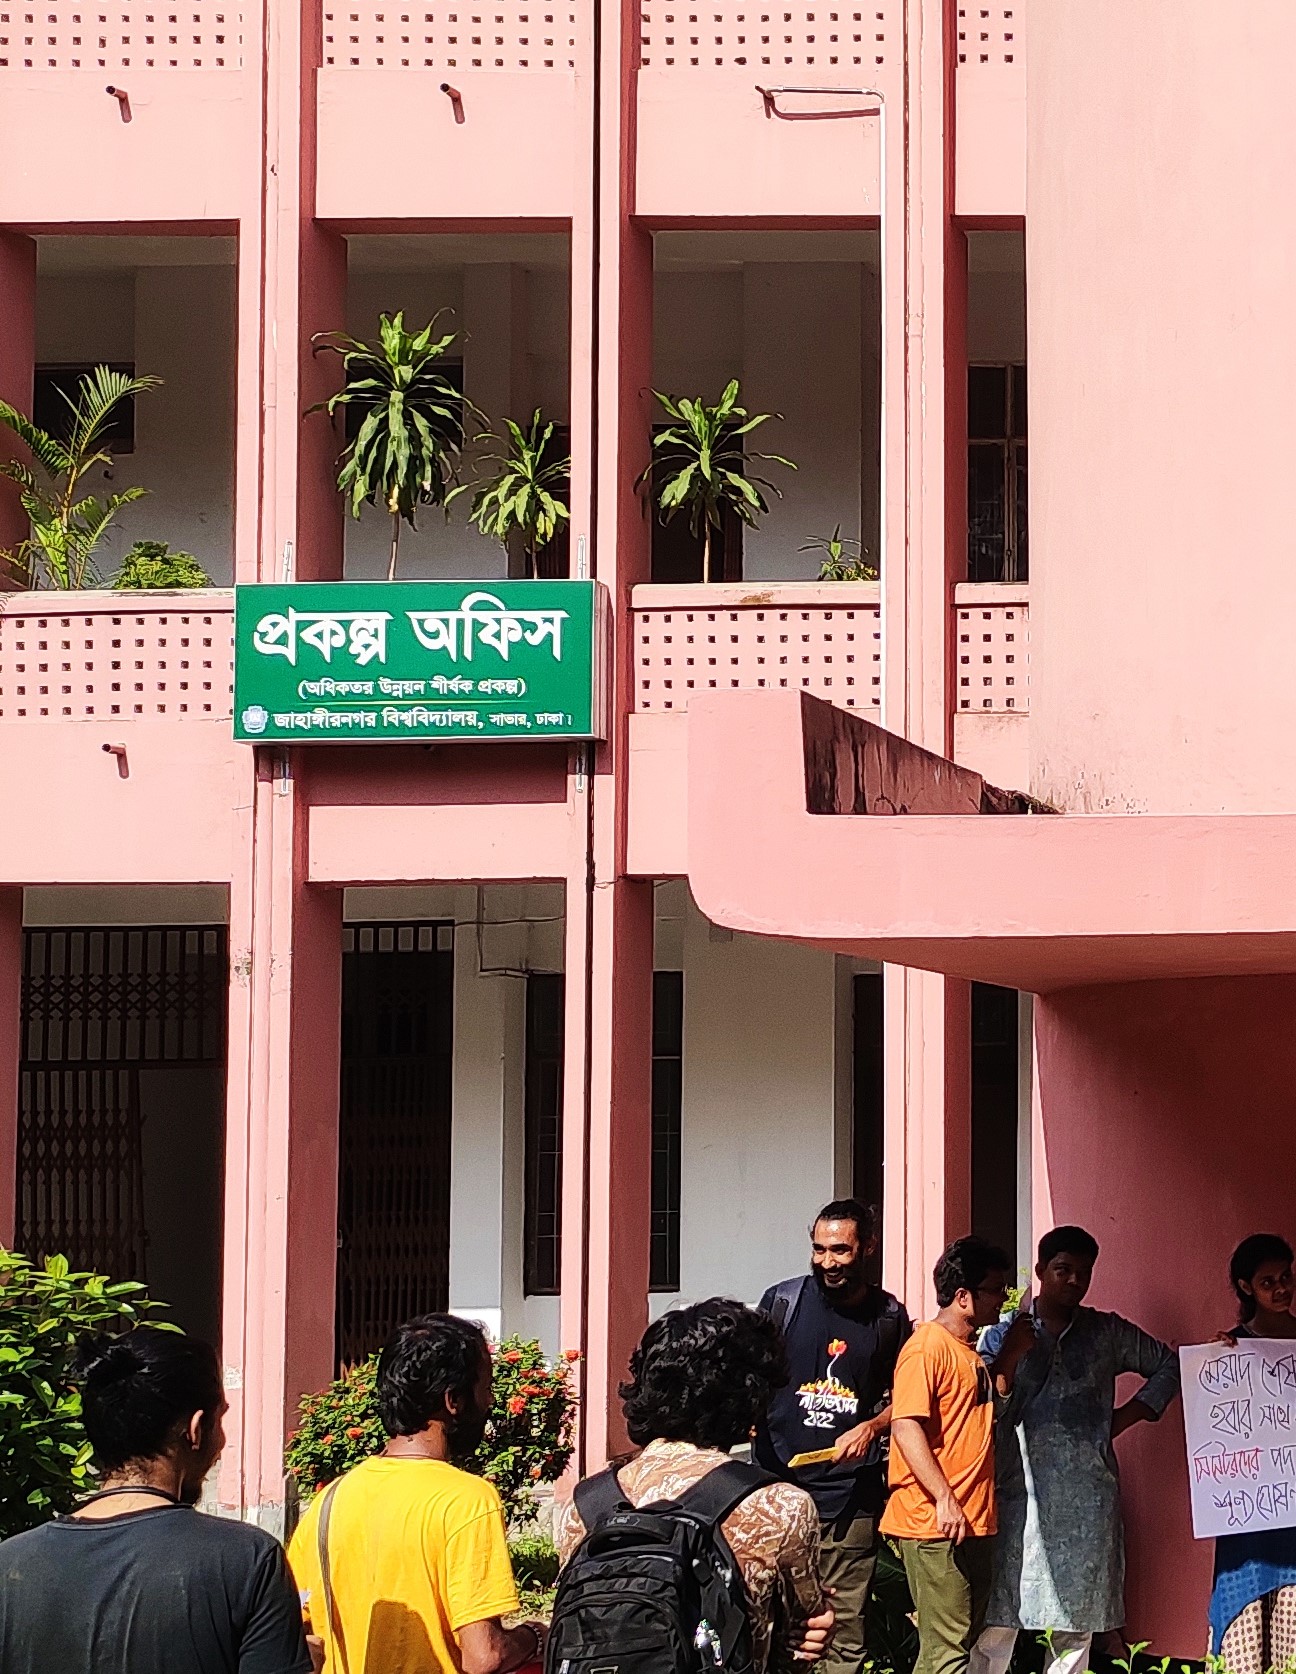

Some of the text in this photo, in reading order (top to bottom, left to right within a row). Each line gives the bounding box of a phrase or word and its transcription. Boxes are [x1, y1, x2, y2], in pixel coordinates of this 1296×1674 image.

[253, 590, 571, 667] প্রকল্প অফিস
[297, 674, 527, 700] (অধিকতর উন্নয়ন শীর্ষক প্রকল্প)
[272, 707, 378, 730] জাহাঙ্গীরনগর
[380, 706, 486, 730] বিশ্ববিদ্যালয়,
[488, 712, 532, 729] সাভার,
[1198, 1352, 1256, 1397] মেয়াদ
[1209, 1398, 1253, 1440] হবার
[1259, 1402, 1291, 1431] সাথে
